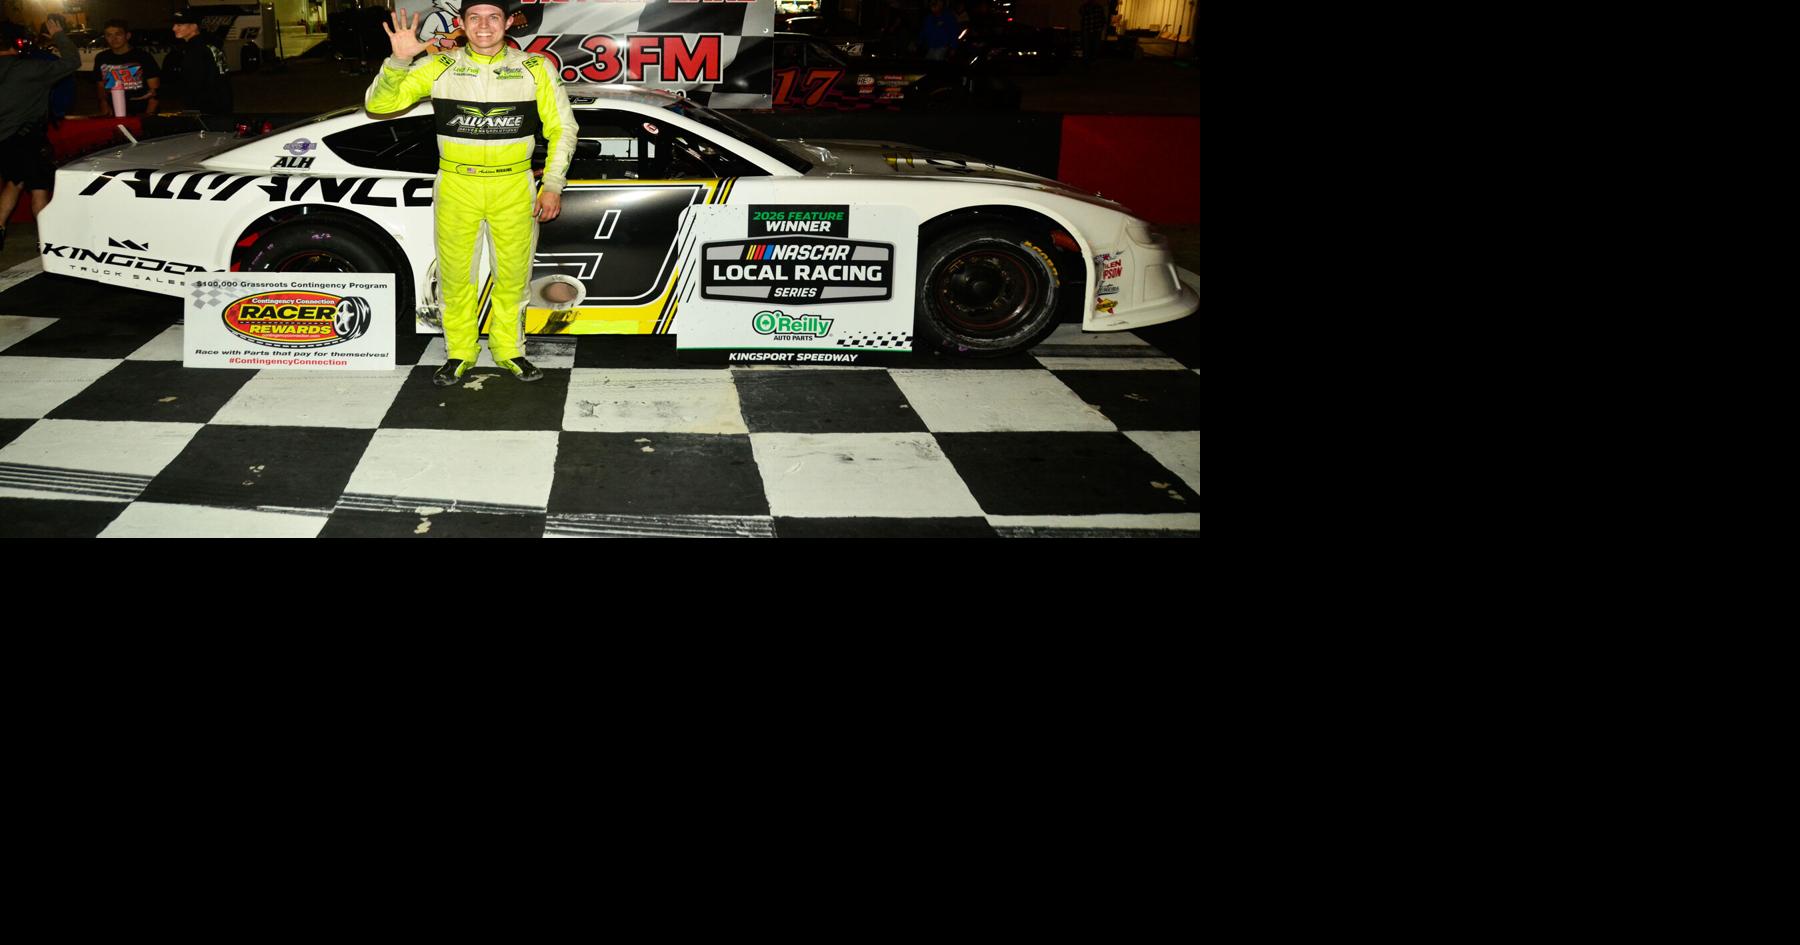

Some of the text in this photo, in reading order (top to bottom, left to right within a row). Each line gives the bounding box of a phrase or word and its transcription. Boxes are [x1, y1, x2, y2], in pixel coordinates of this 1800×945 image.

[504, 33, 723, 84] 6.3FM
[773, 68, 844, 107] 17
[448, 114, 523, 127] ALLIANCE
[272, 156, 316, 168] ALH
[753, 212, 845, 221] 2026 FEATURE
[766, 220, 831, 232] WINNER
[771, 244, 851, 261] NASCAR
[69, 264, 186, 287] TRUCK SALES
[713, 264, 882, 281] LOCAL RACING
[195, 280, 238, 289] $100,000
[290, 281, 347, 289] Contingency
[349, 282, 388, 290] Program
[774, 287, 818, 298] SERIES
[239, 304, 336, 321] RACER
[249, 324, 332, 334] REWARDS
[754, 311, 833, 336] O'Reilly
[229, 357, 347, 366] #ContingencyConnection
[728, 352, 858, 362] KINGSPORT SPEEDWAY
